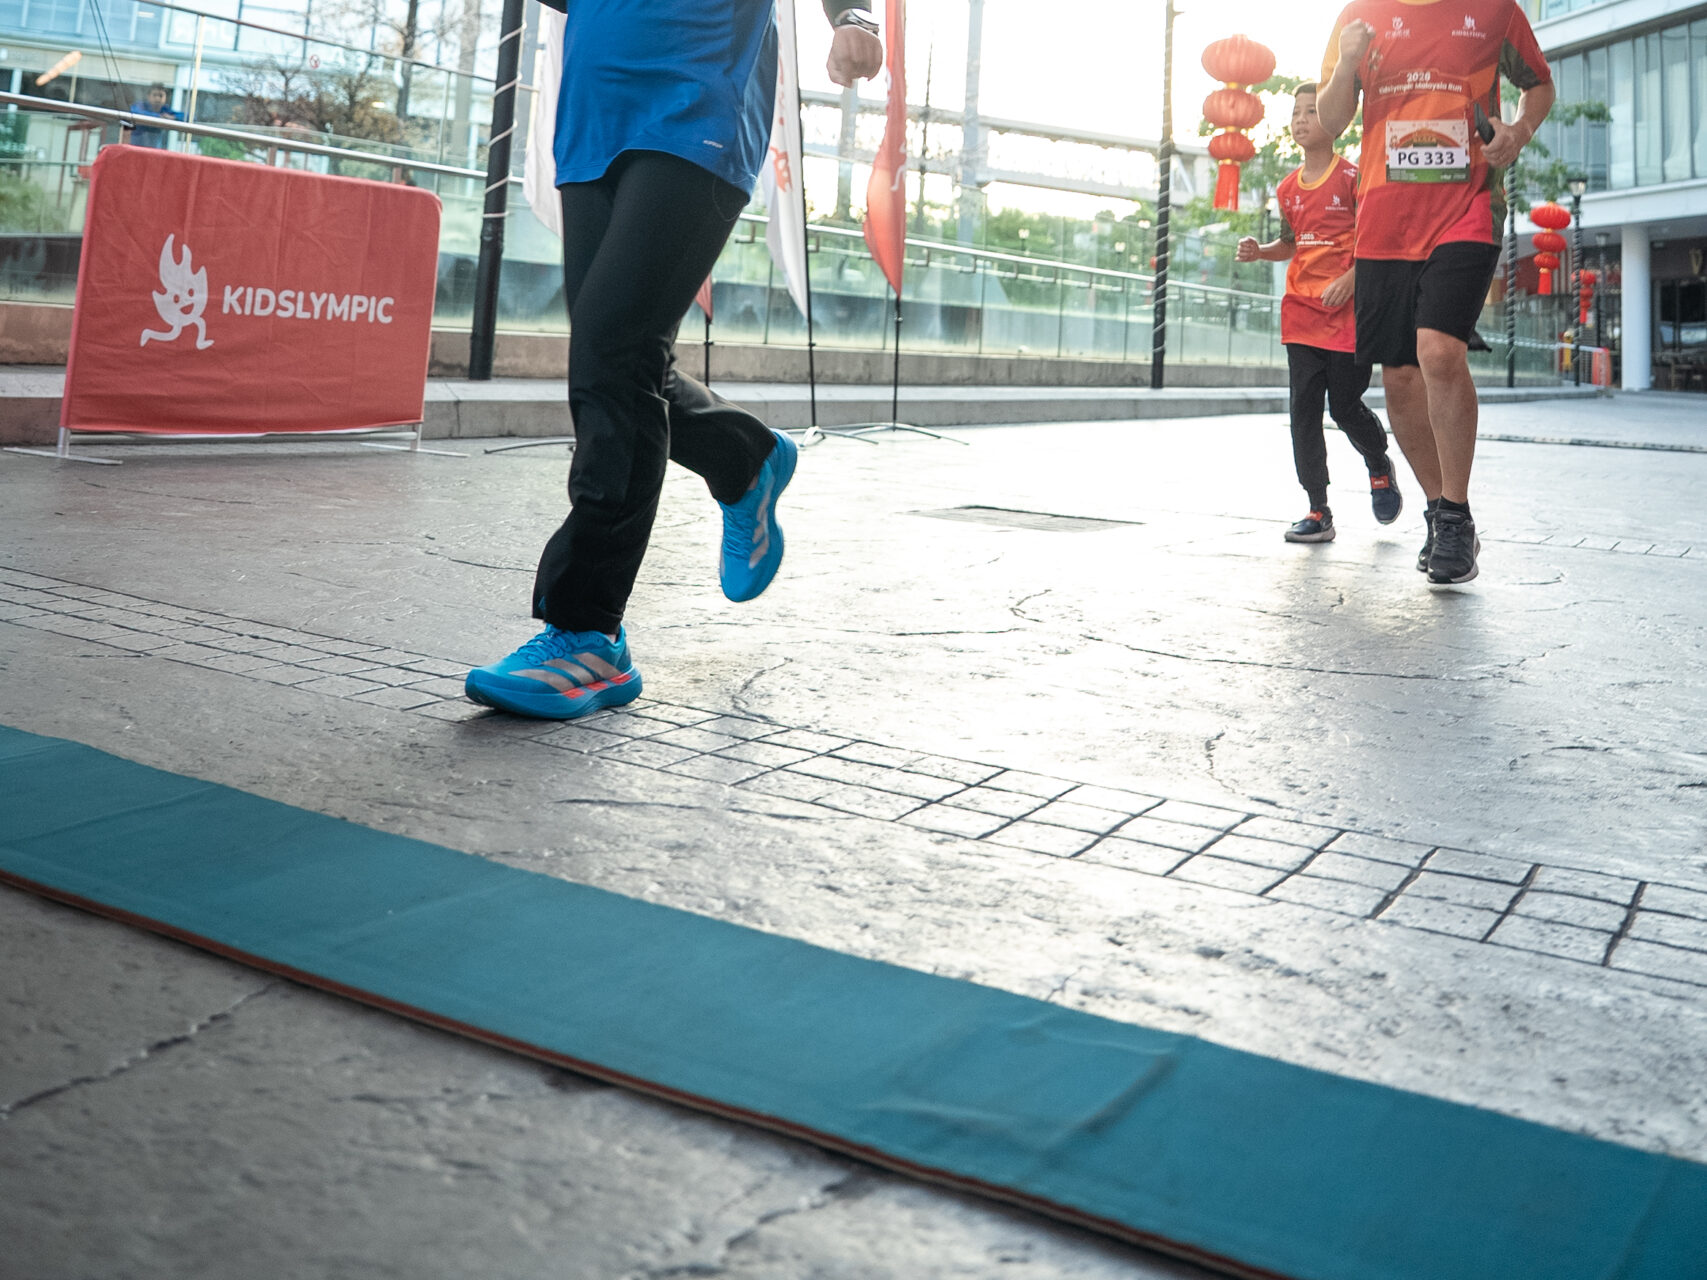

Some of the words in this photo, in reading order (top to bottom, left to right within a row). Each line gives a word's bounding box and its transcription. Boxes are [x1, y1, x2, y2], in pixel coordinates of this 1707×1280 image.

[1398, 151, 1419, 165] PG
[1424, 151, 1455, 165] 333
[222, 285, 395, 324] KIDSLYMPIC
